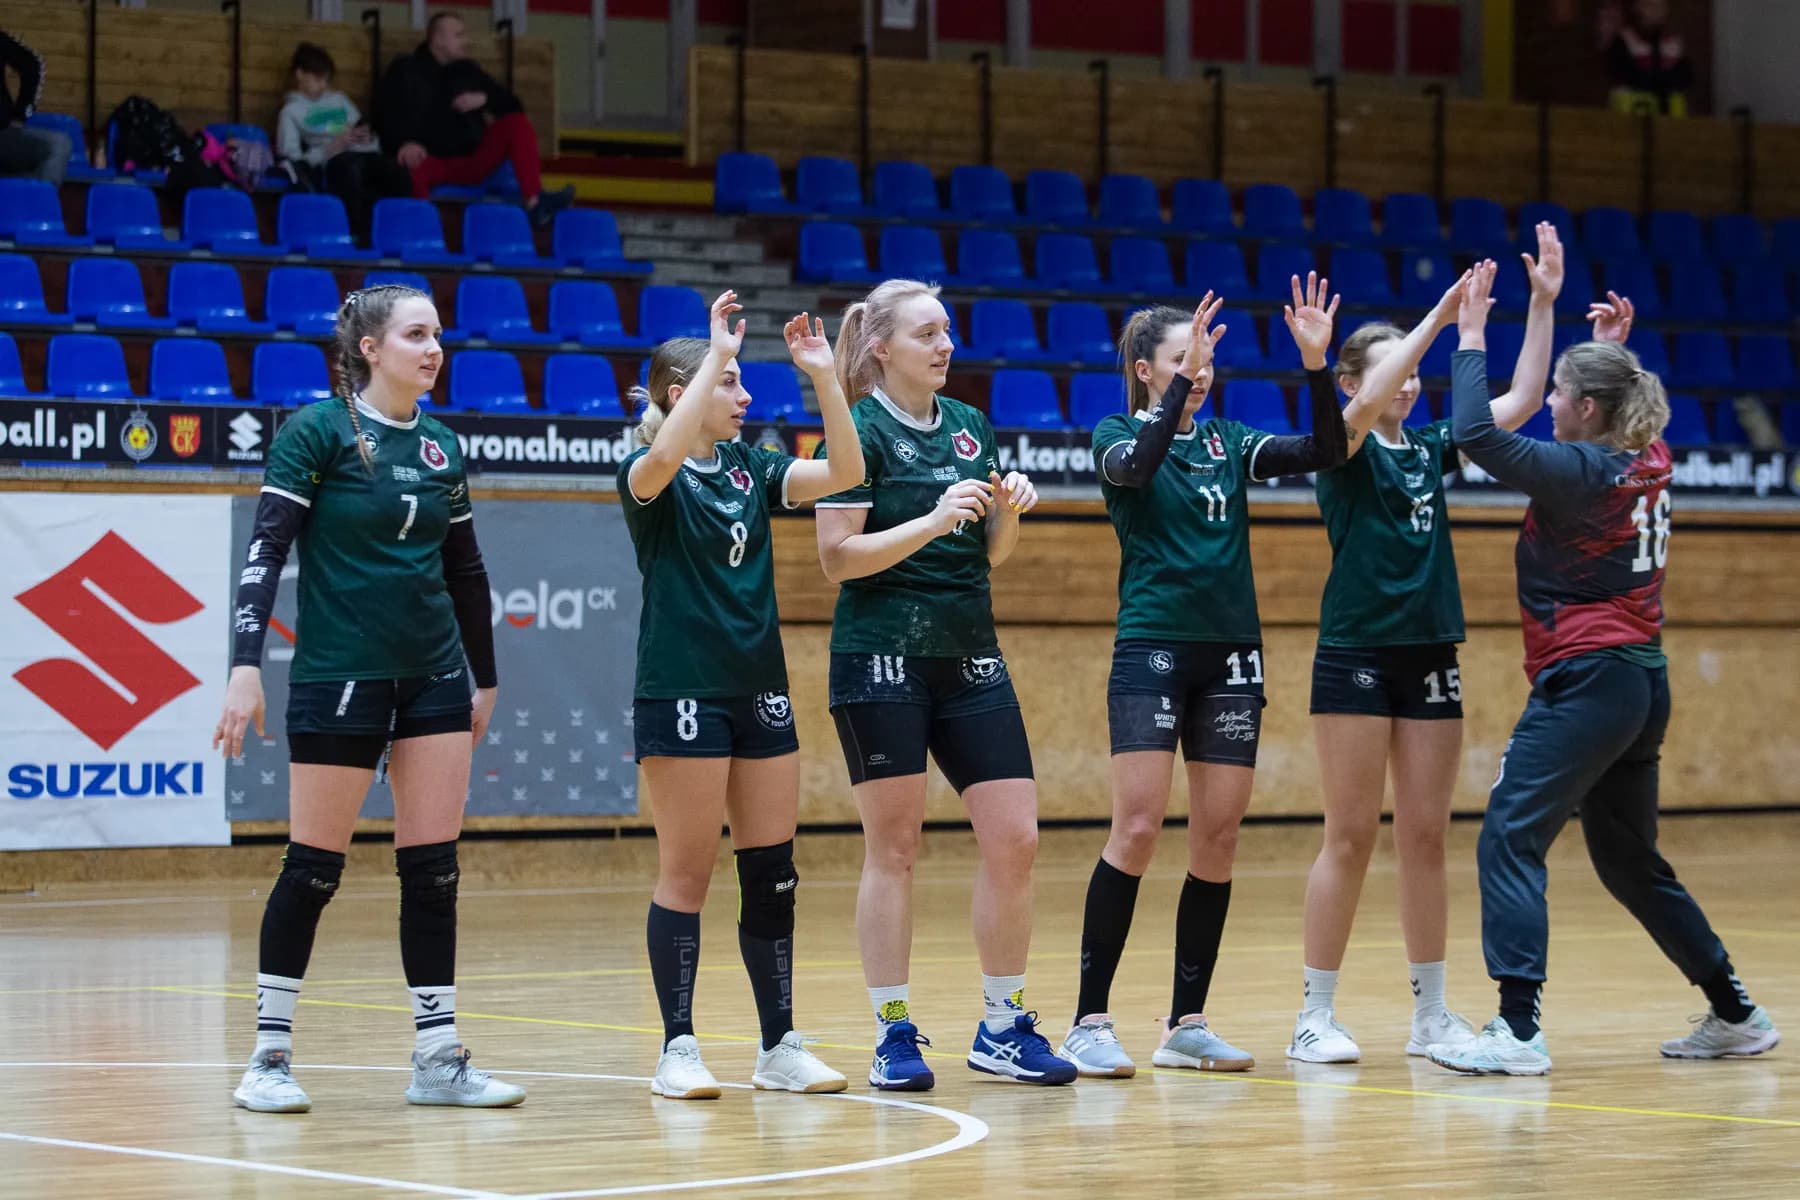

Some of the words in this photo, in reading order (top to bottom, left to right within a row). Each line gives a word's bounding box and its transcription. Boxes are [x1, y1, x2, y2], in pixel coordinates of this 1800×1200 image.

[398, 494, 418, 540] 7
[1197, 484, 1226, 521] 11
[729, 521, 748, 567] 8
[1631, 489, 1671, 573] 16
[586, 586, 617, 610] CK
[1226, 650, 1263, 685] 11
[1424, 668, 1462, 703] 15
[677, 698, 698, 741] 8
[1154, 713, 1177, 723] WHITE
[8, 762, 203, 798] SUZUKI
[775, 878, 797, 891] SELEC
[672, 935, 697, 1022] kalenji
[772, 934, 794, 1010] kalen
